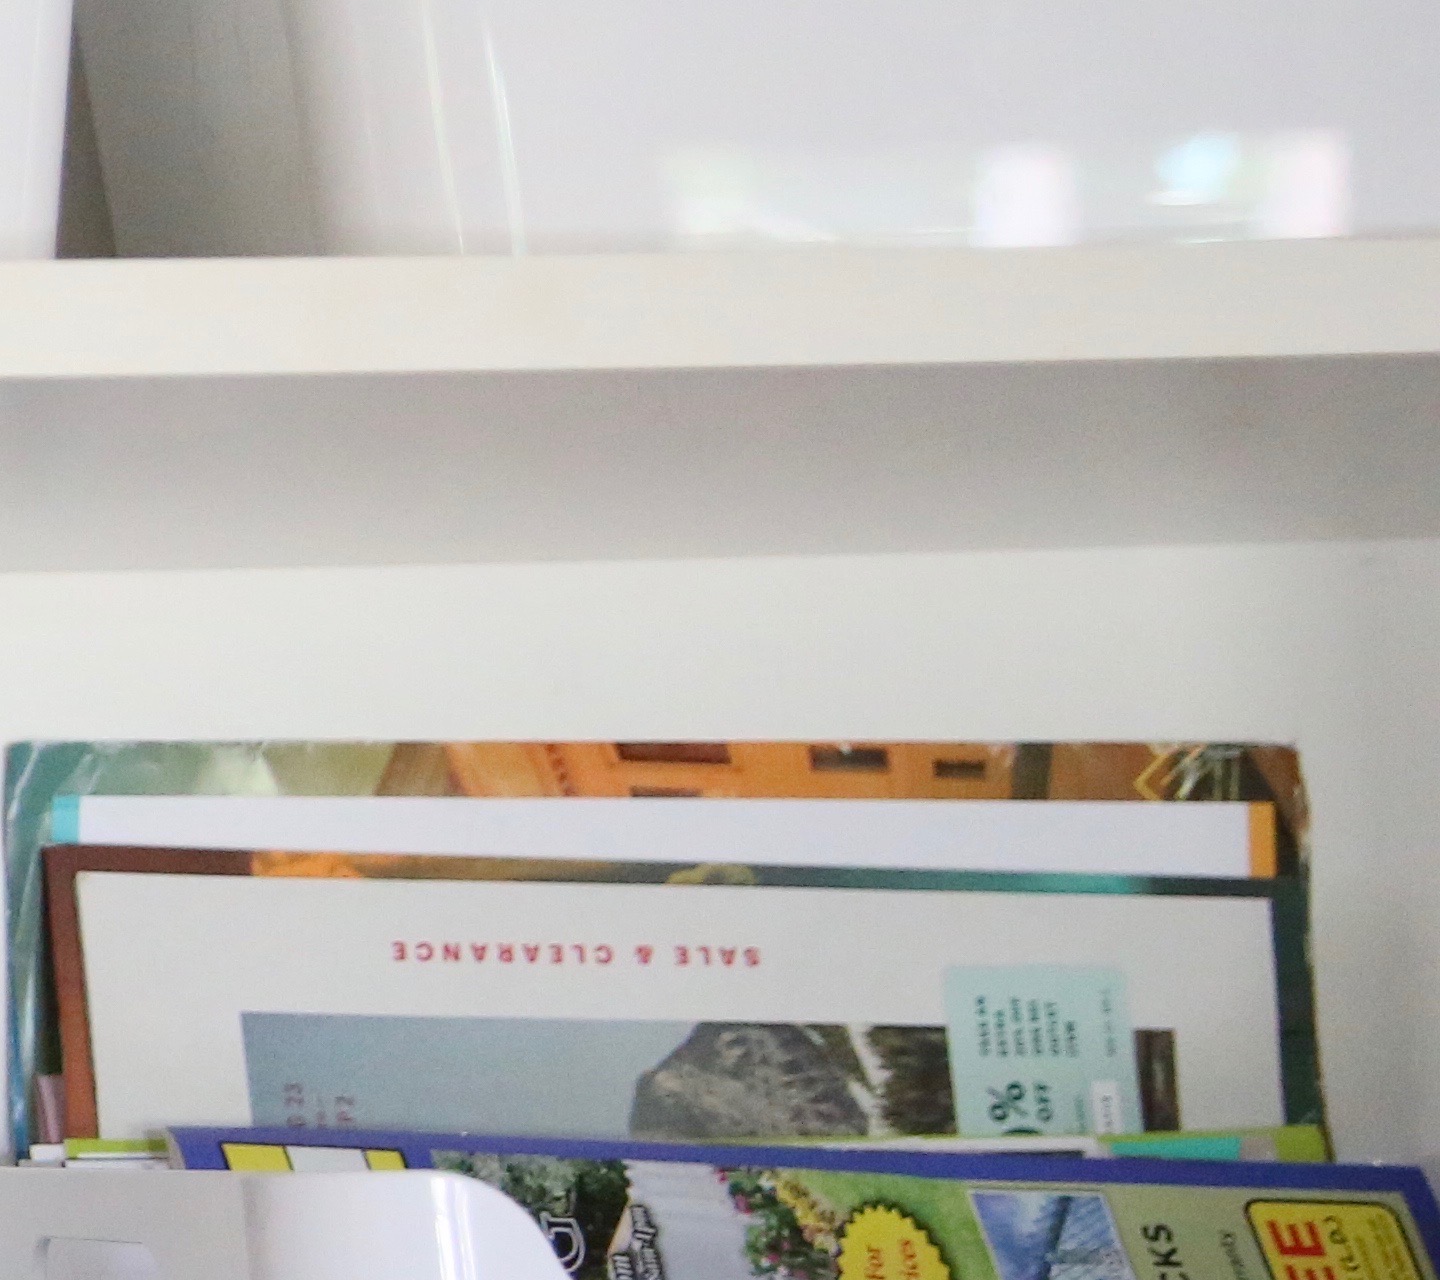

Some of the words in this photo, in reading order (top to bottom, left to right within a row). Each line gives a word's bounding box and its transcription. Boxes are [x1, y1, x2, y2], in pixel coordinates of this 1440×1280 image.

[390, 940, 614, 965] CLEARANCE
[635, 945, 655, 965] &
[674, 945, 762, 968] SALE
